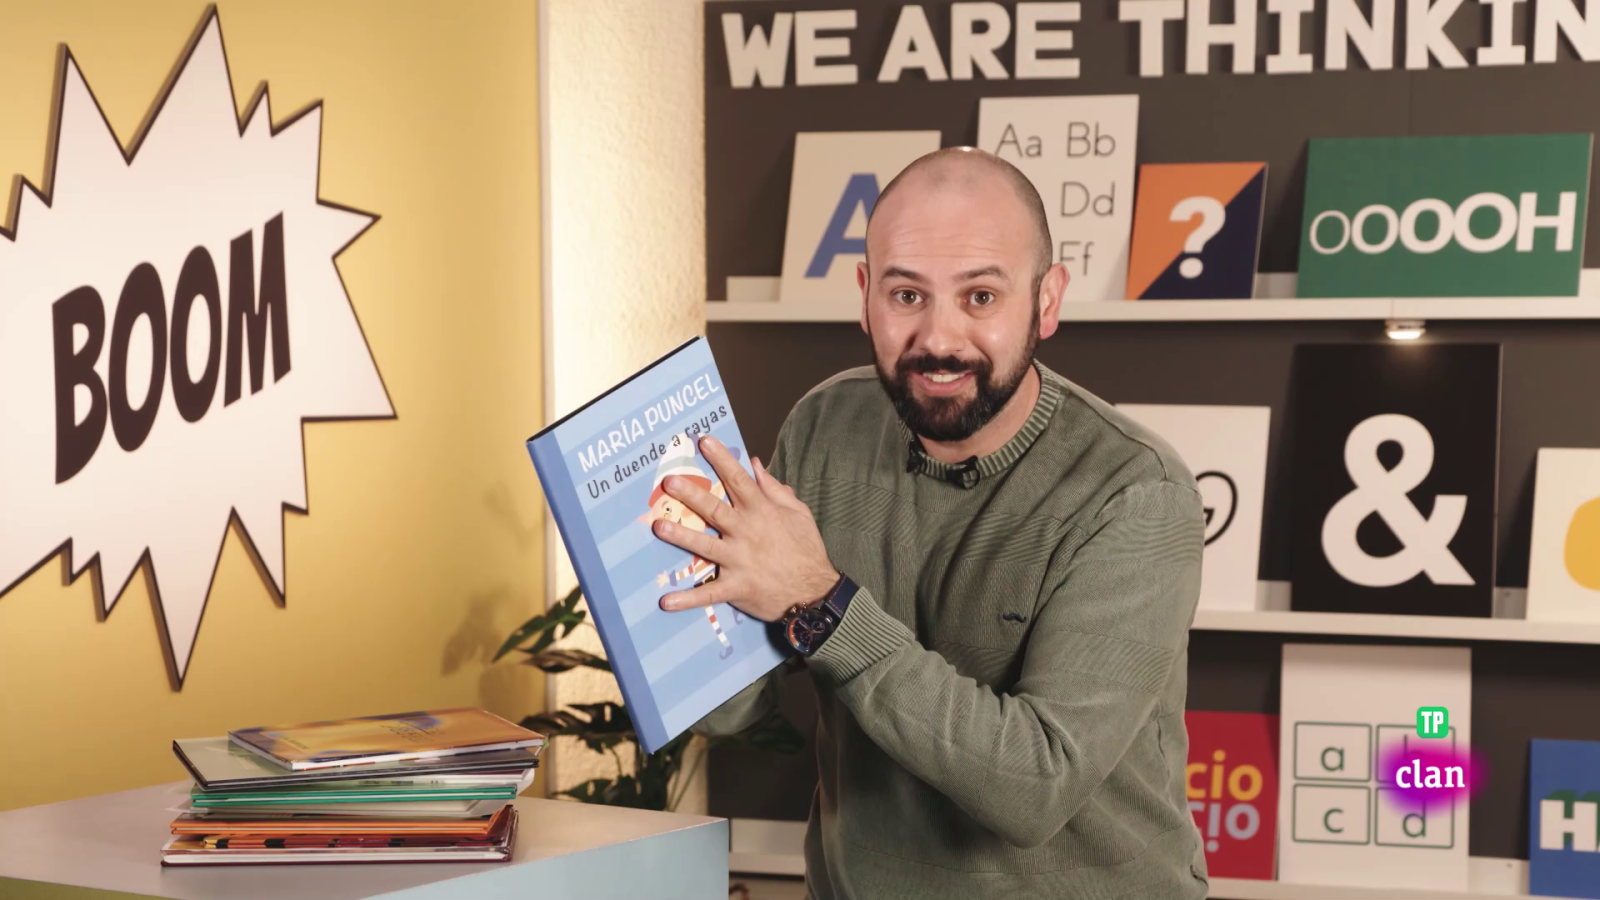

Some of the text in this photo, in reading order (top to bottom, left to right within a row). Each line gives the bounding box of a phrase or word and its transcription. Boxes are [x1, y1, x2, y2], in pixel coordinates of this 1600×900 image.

[721, 9, 858, 89] WE
[877, 1, 1081, 83] ARE
[994, 121, 1117, 159] Aa Bb
[1060, 181, 1116, 218] Dd
[1059, 240, 1095, 277] Ff
[1169, 195, 1226, 280] ?
[51, 210, 292, 485] BOOM
[577, 372, 721, 473] MARÍA PUNCEL
[587, 404, 728, 499] Un duende a rayas
[1321, 413, 1477, 588] &
[1320, 746, 1345, 772] a
[1323, 808, 1345, 834] c
[1539, 798, 1600, 853] H
